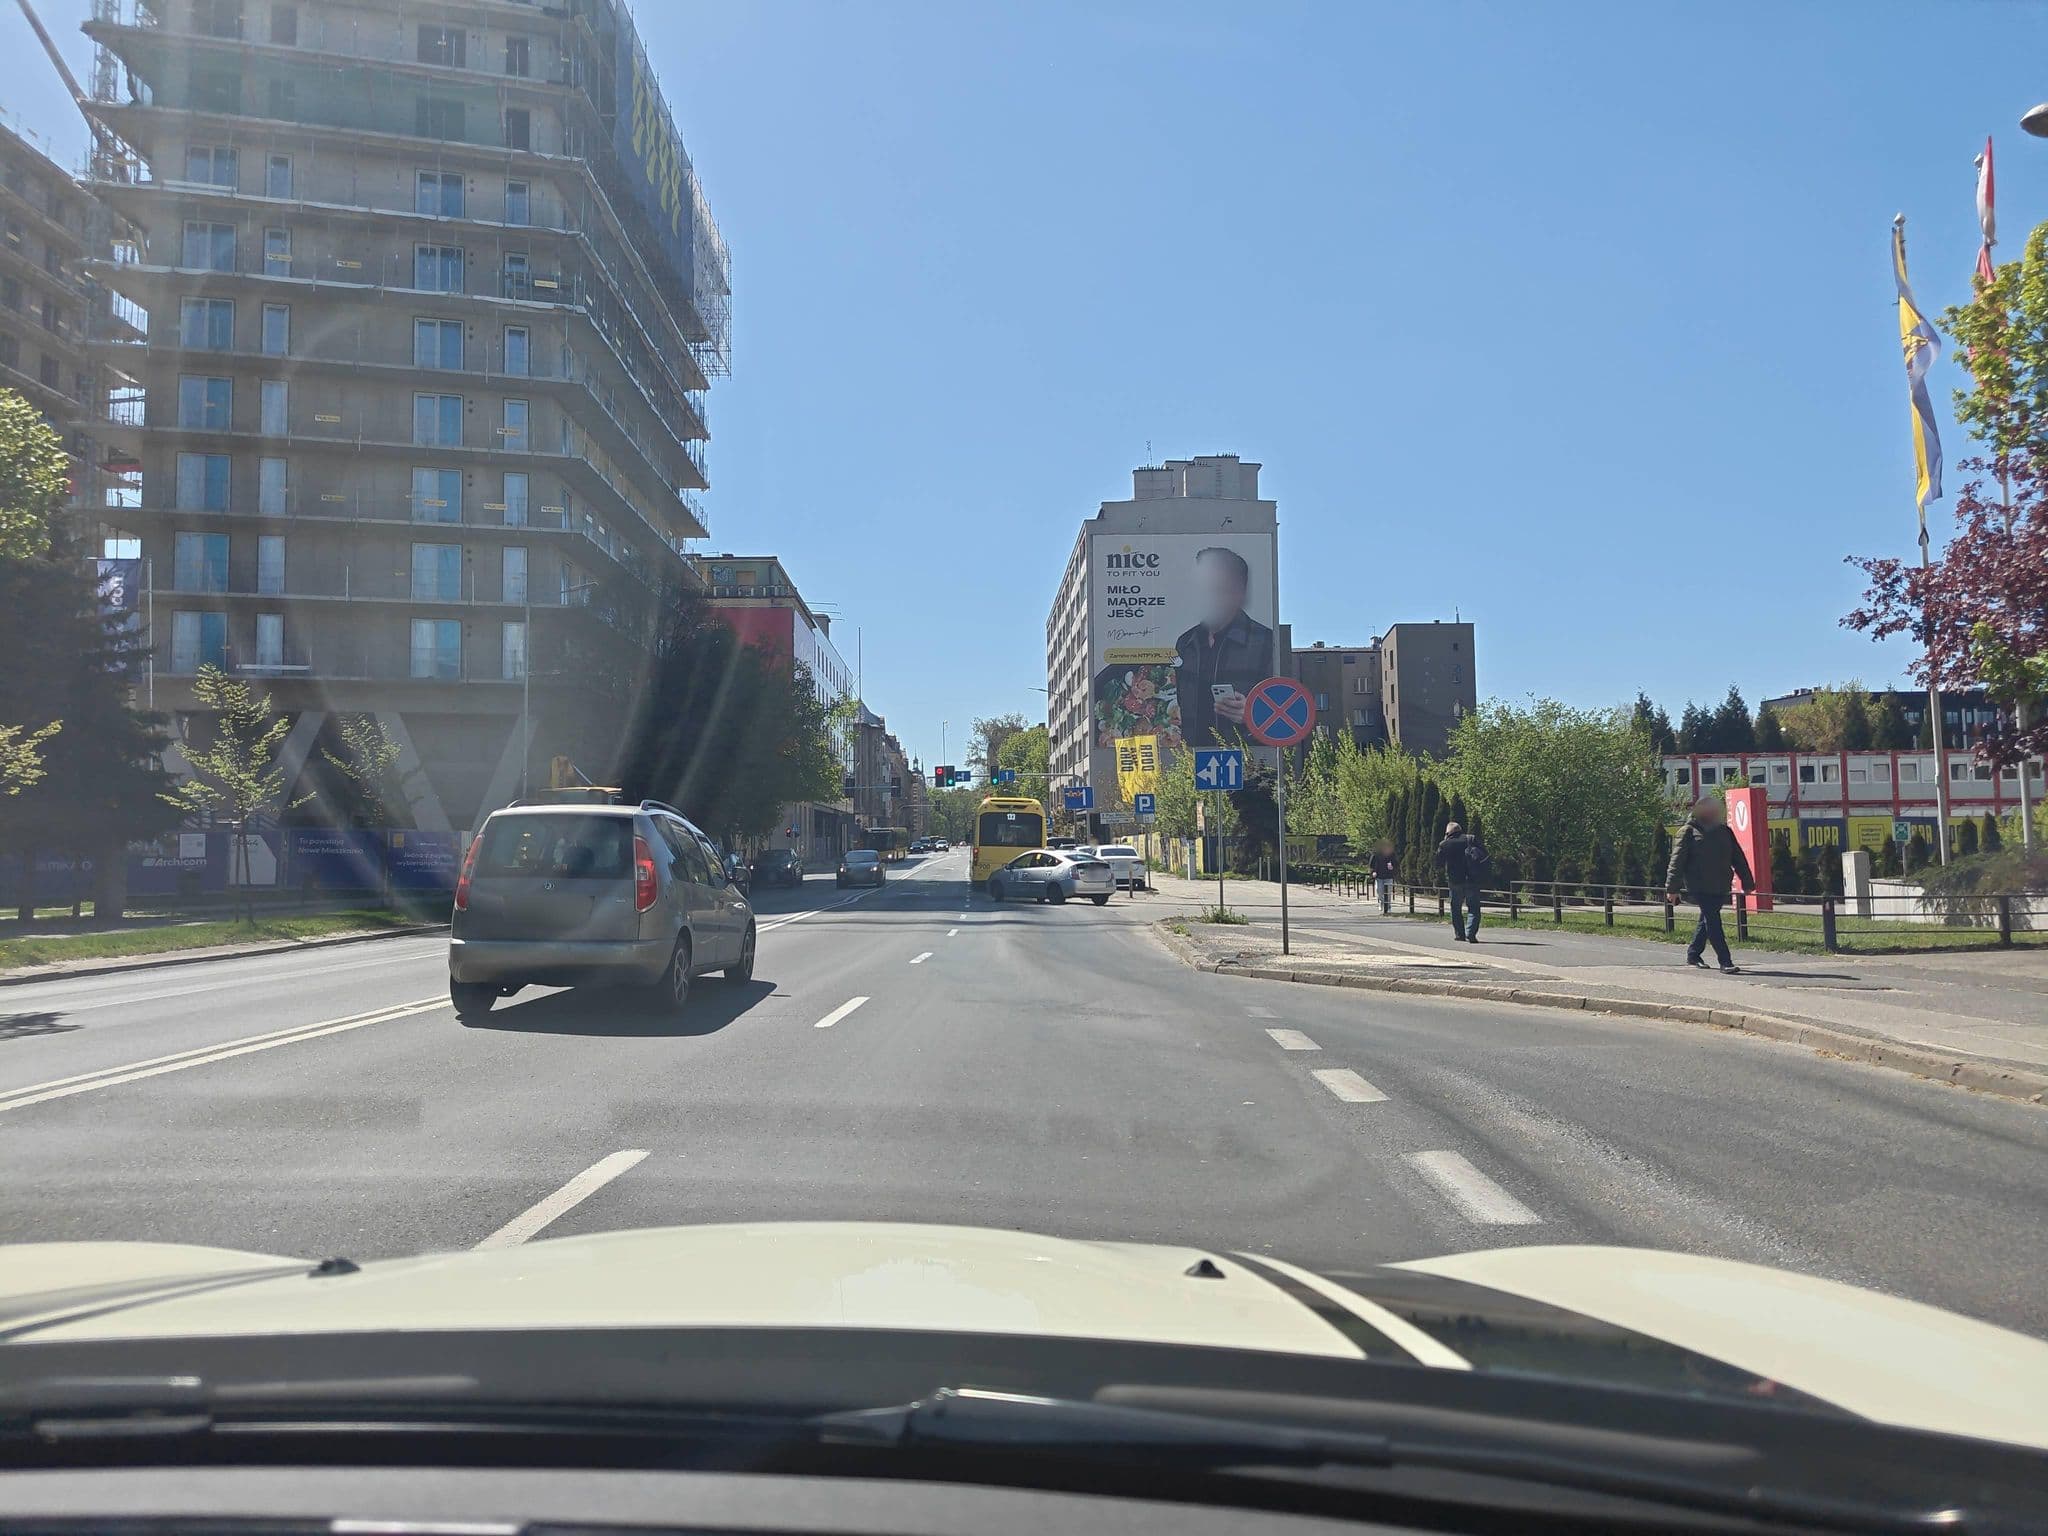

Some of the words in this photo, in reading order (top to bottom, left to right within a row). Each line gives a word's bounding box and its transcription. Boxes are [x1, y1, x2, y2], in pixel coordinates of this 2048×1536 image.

[1106, 546, 1160, 569] nice
[1107, 585, 1141, 594] MIŁO
[1107, 597, 1166, 608] MĄDRZE
[1107, 608, 1145, 618] JEŚĆ
[1139, 796, 1151, 812] P
[154, 857, 208, 867] Archicom
